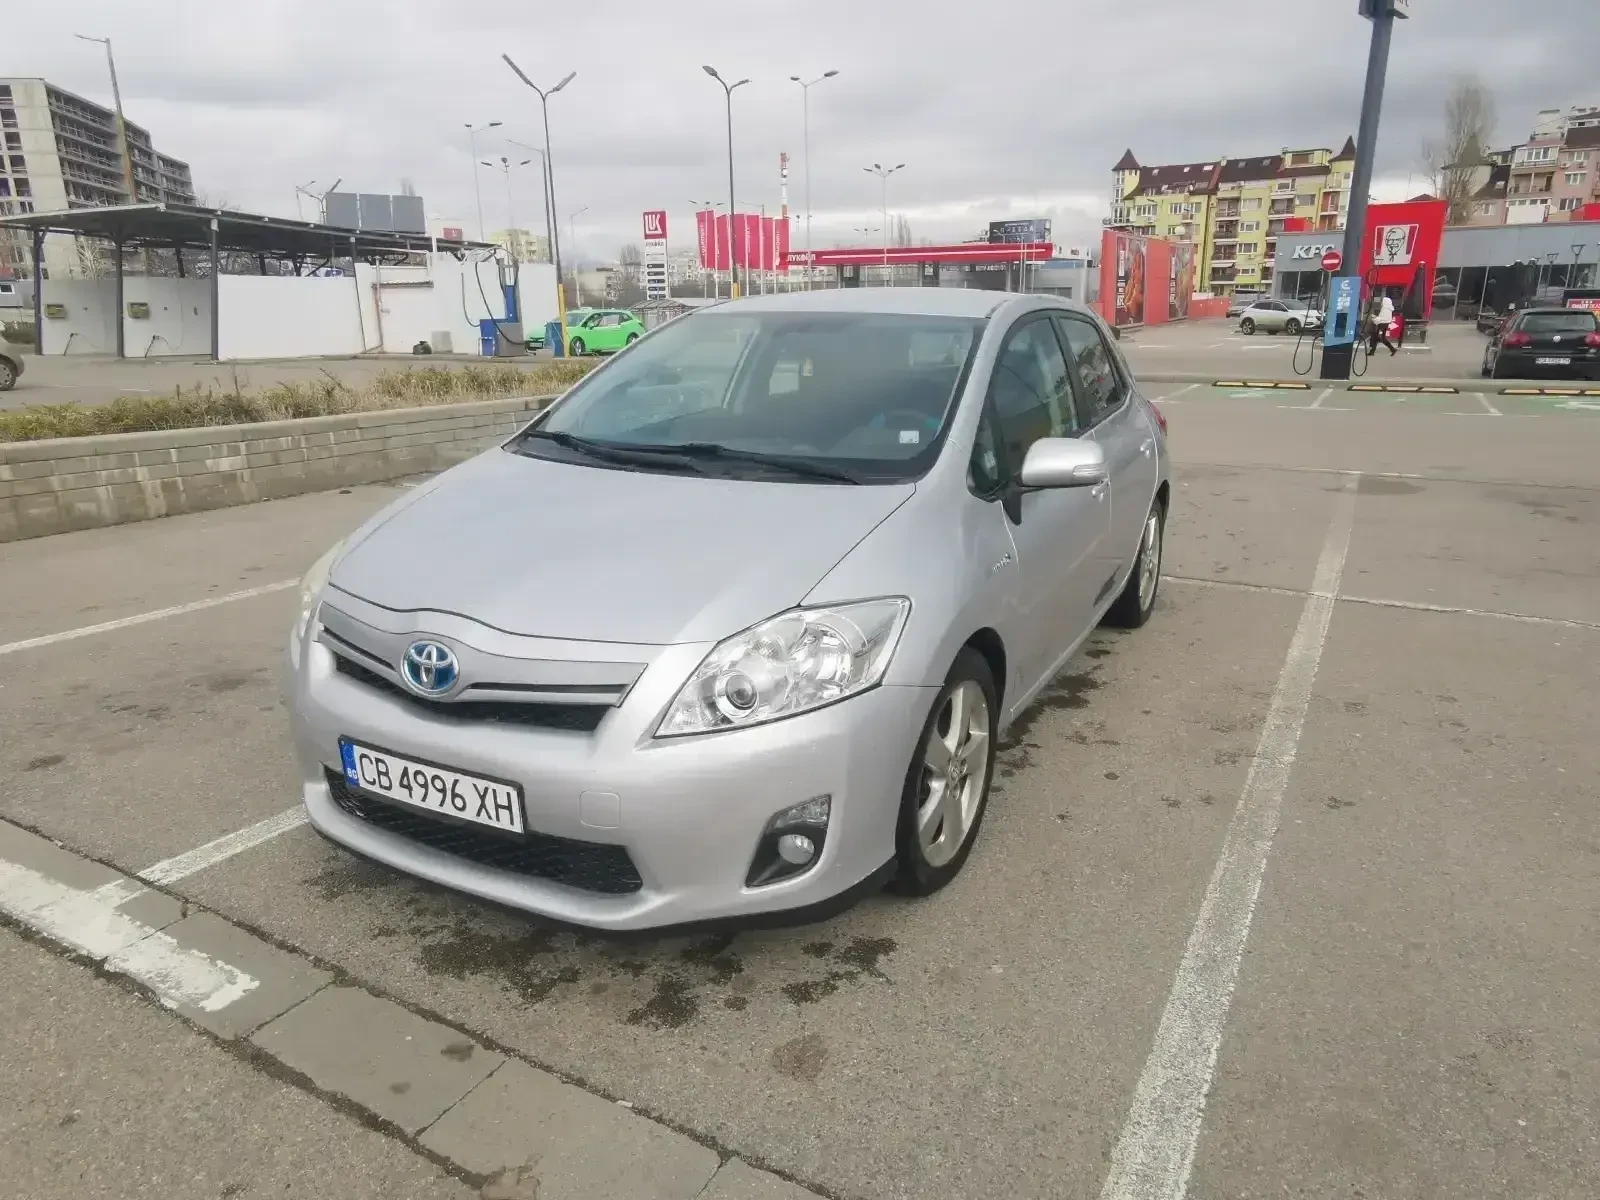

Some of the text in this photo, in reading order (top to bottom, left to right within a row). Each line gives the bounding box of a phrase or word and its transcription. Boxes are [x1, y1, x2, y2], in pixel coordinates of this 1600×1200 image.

[1292, 244, 1335, 259] KFC
[347, 767, 358, 780] BG
[359, 753, 515, 826] CB 4996 XH
